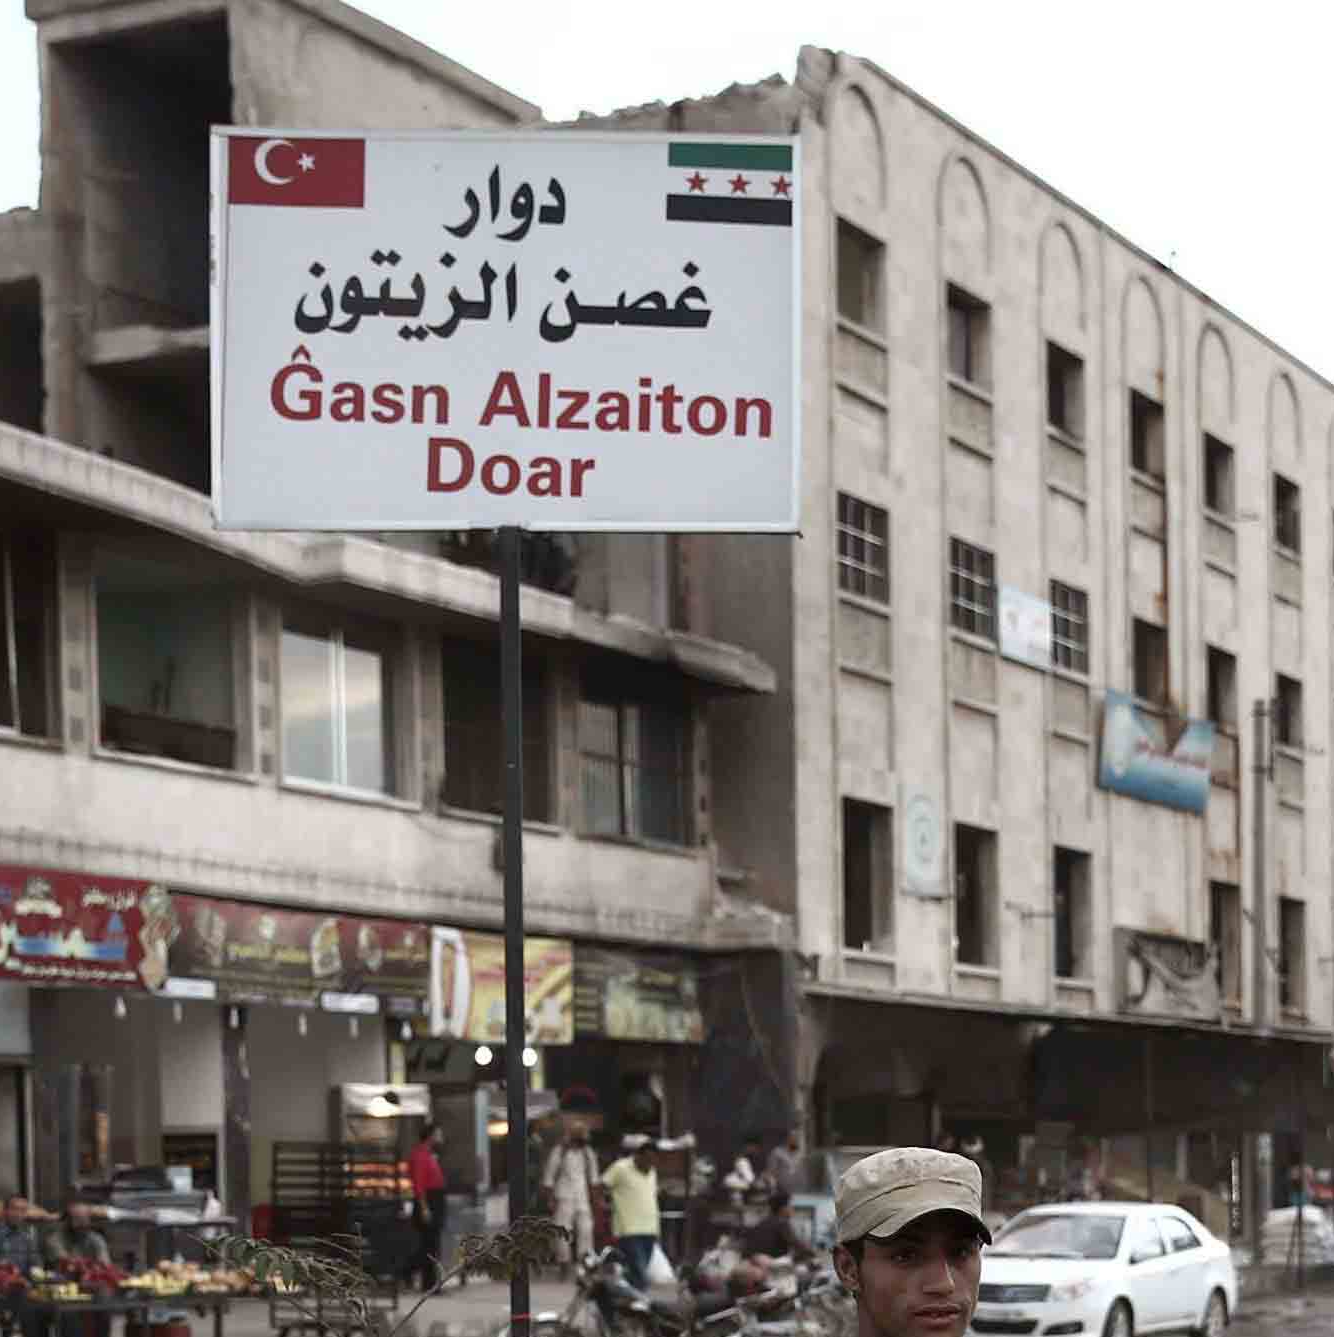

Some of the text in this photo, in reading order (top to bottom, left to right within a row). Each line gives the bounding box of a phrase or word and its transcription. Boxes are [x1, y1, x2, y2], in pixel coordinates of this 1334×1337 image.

[443, 164, 566, 242] دوار
[294, 249, 712, 342] غصن الزيتون
[270, 345, 773, 438] Ĝasn Alzaiton
[426, 437, 595, 497] Doar
